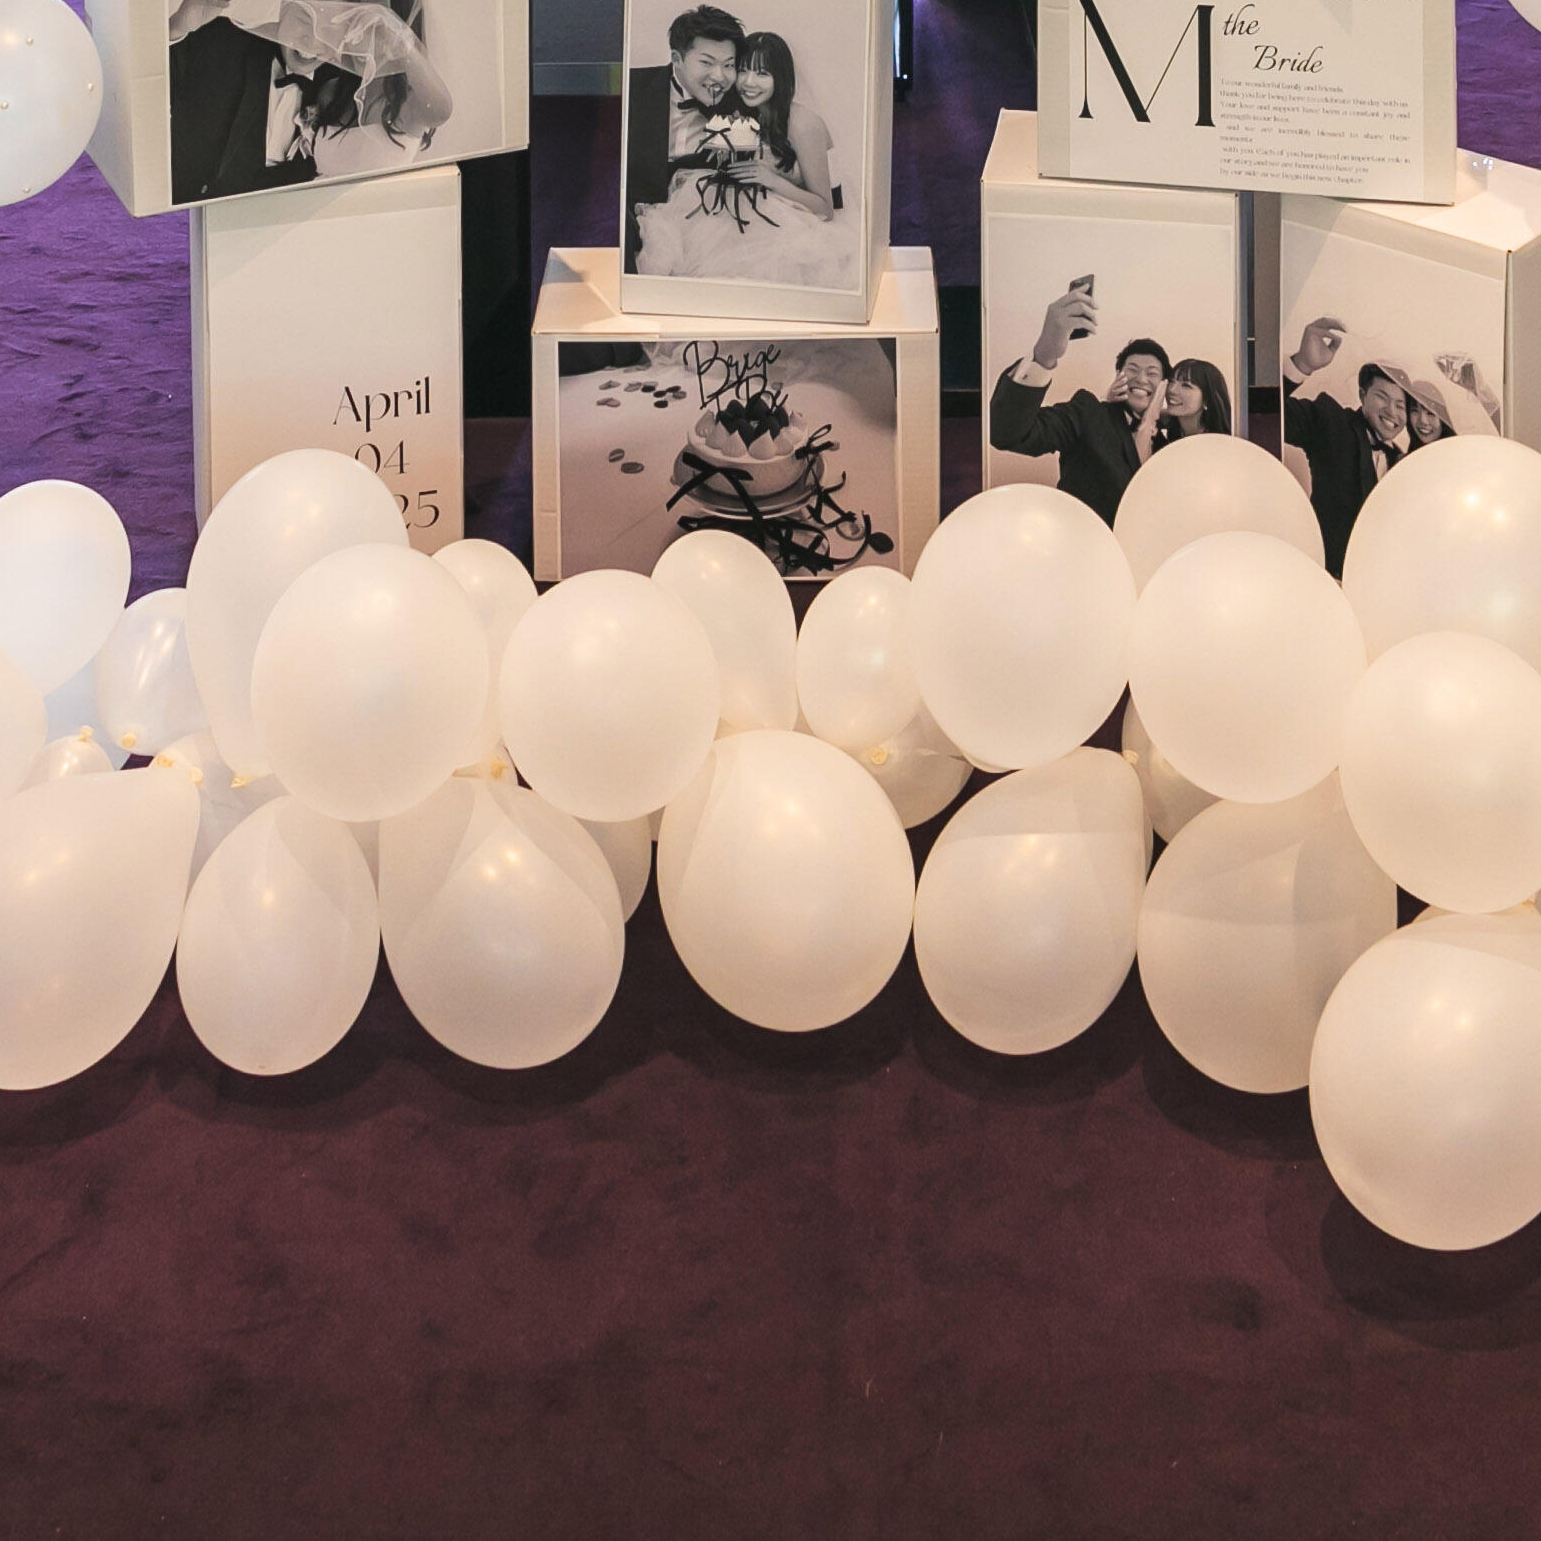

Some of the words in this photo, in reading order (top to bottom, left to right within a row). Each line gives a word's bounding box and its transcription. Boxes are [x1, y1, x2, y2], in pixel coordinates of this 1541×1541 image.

[1222, 3, 1260, 37] the
[1252, 44, 1324, 74] Bride
[333, 376, 431, 433] April
[354, 440, 410, 475] 04
